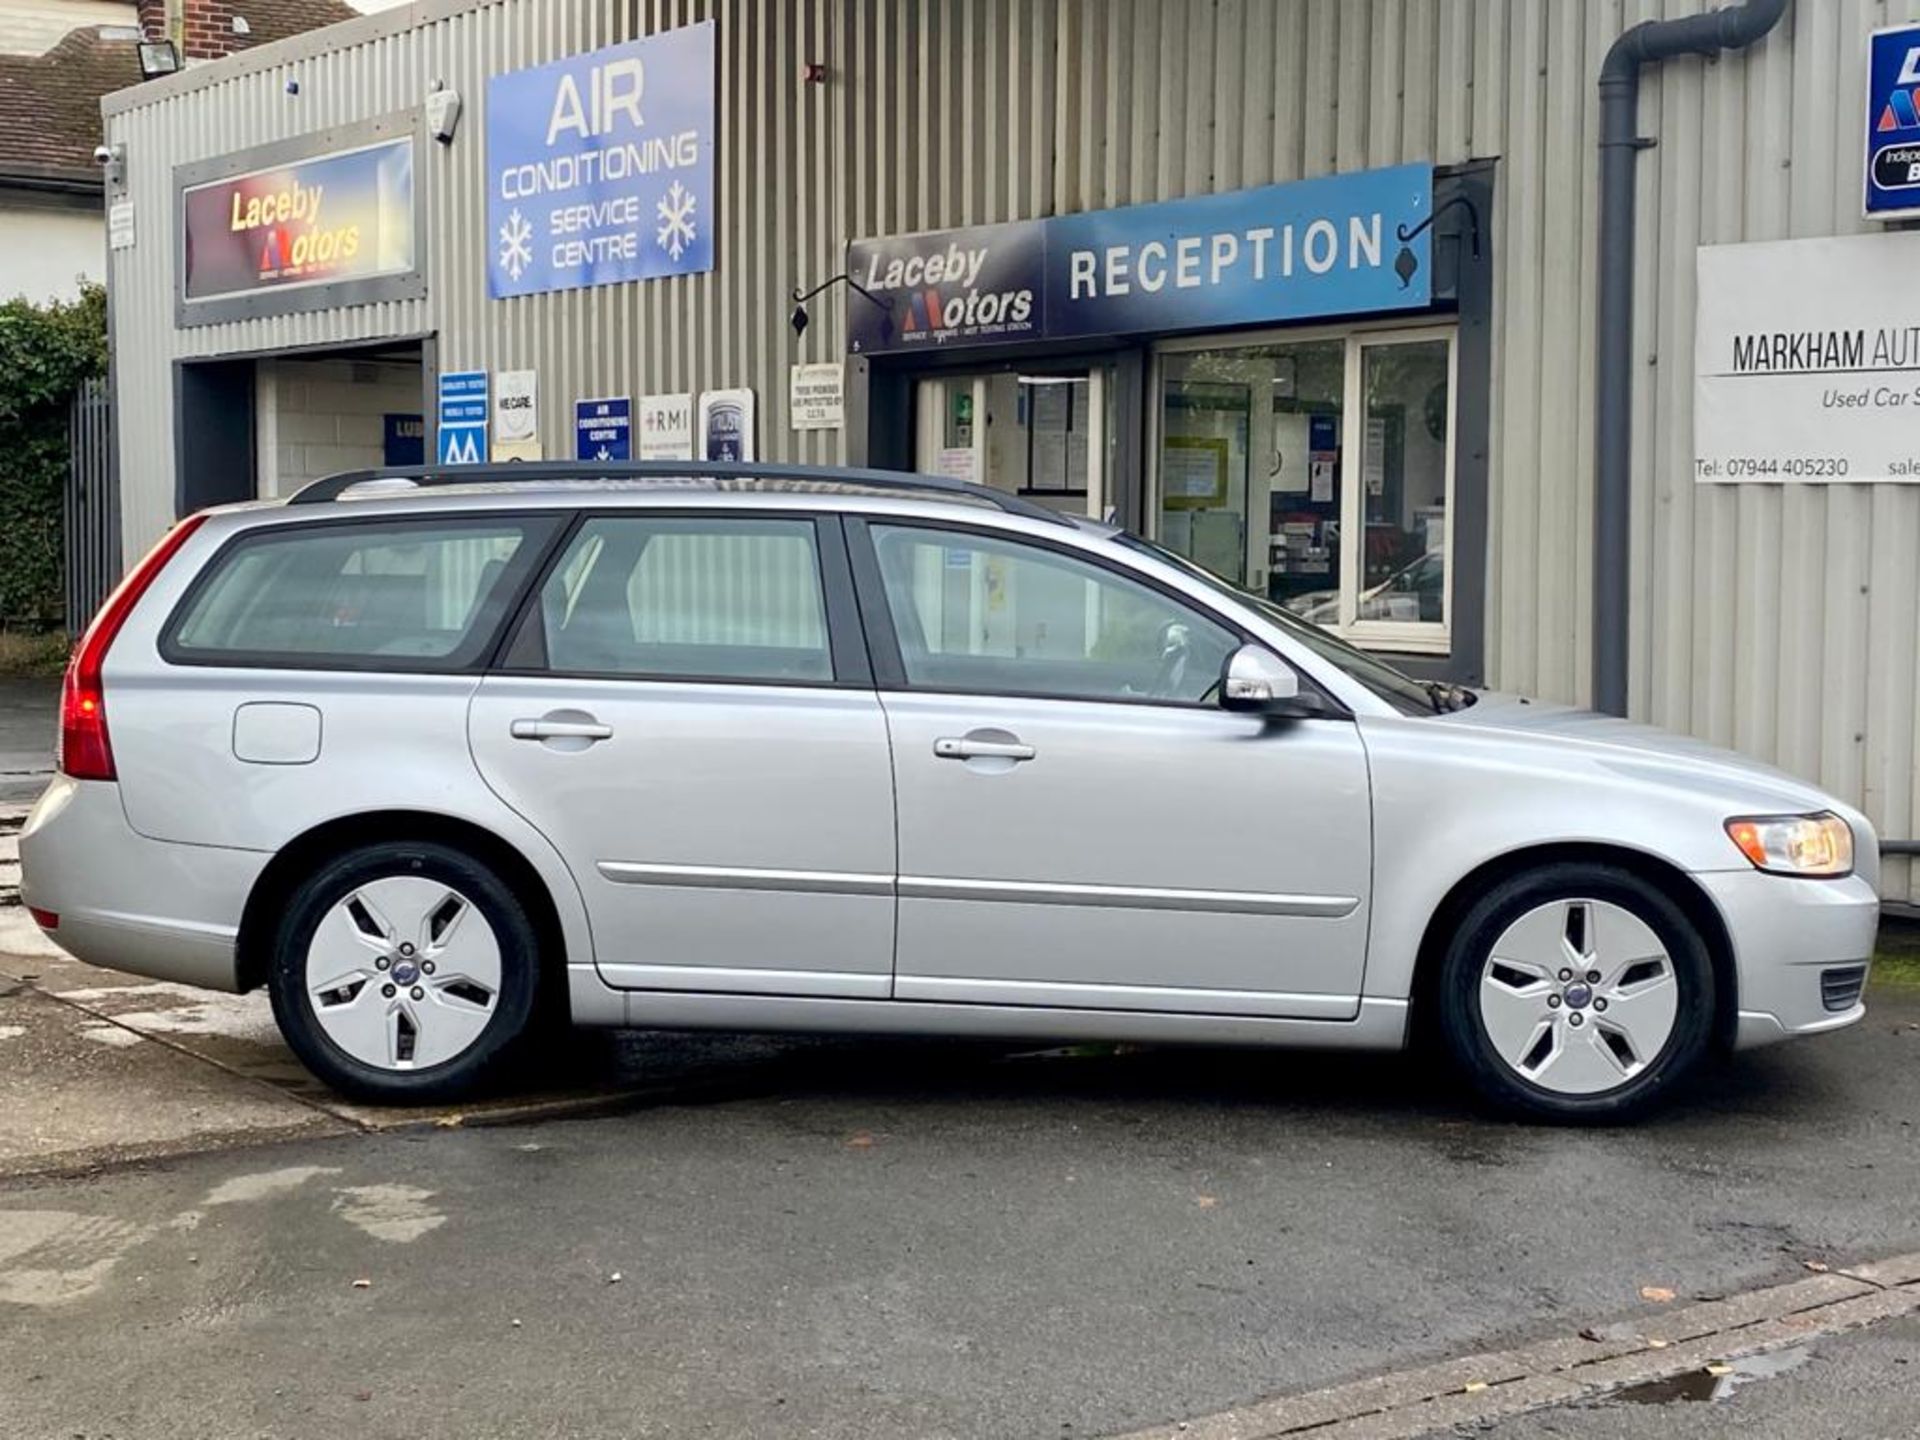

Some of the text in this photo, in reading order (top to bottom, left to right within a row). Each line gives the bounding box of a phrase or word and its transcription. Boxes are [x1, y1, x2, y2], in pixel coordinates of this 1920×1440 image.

[546, 58, 644, 146] AIR
[502, 131, 698, 199] CONDITIONING
[231, 180, 322, 231] Laceby
[551, 196, 639, 235] SERVICE
[552, 233, 637, 268] CENTRE
[866, 243, 988, 292] Laceby
[1070, 213, 1381, 299] RECEPTION
[1733, 329, 1864, 371] MARKHAM
[1823, 389, 1869, 407] Used
[1874, 387, 1908, 406] Car
[657, 410, 687, 432] RMI
[1695, 459, 1721, 476] Tel:
[1727, 459, 1777, 476] 07944
[1782, 459, 1848, 476] 405230
